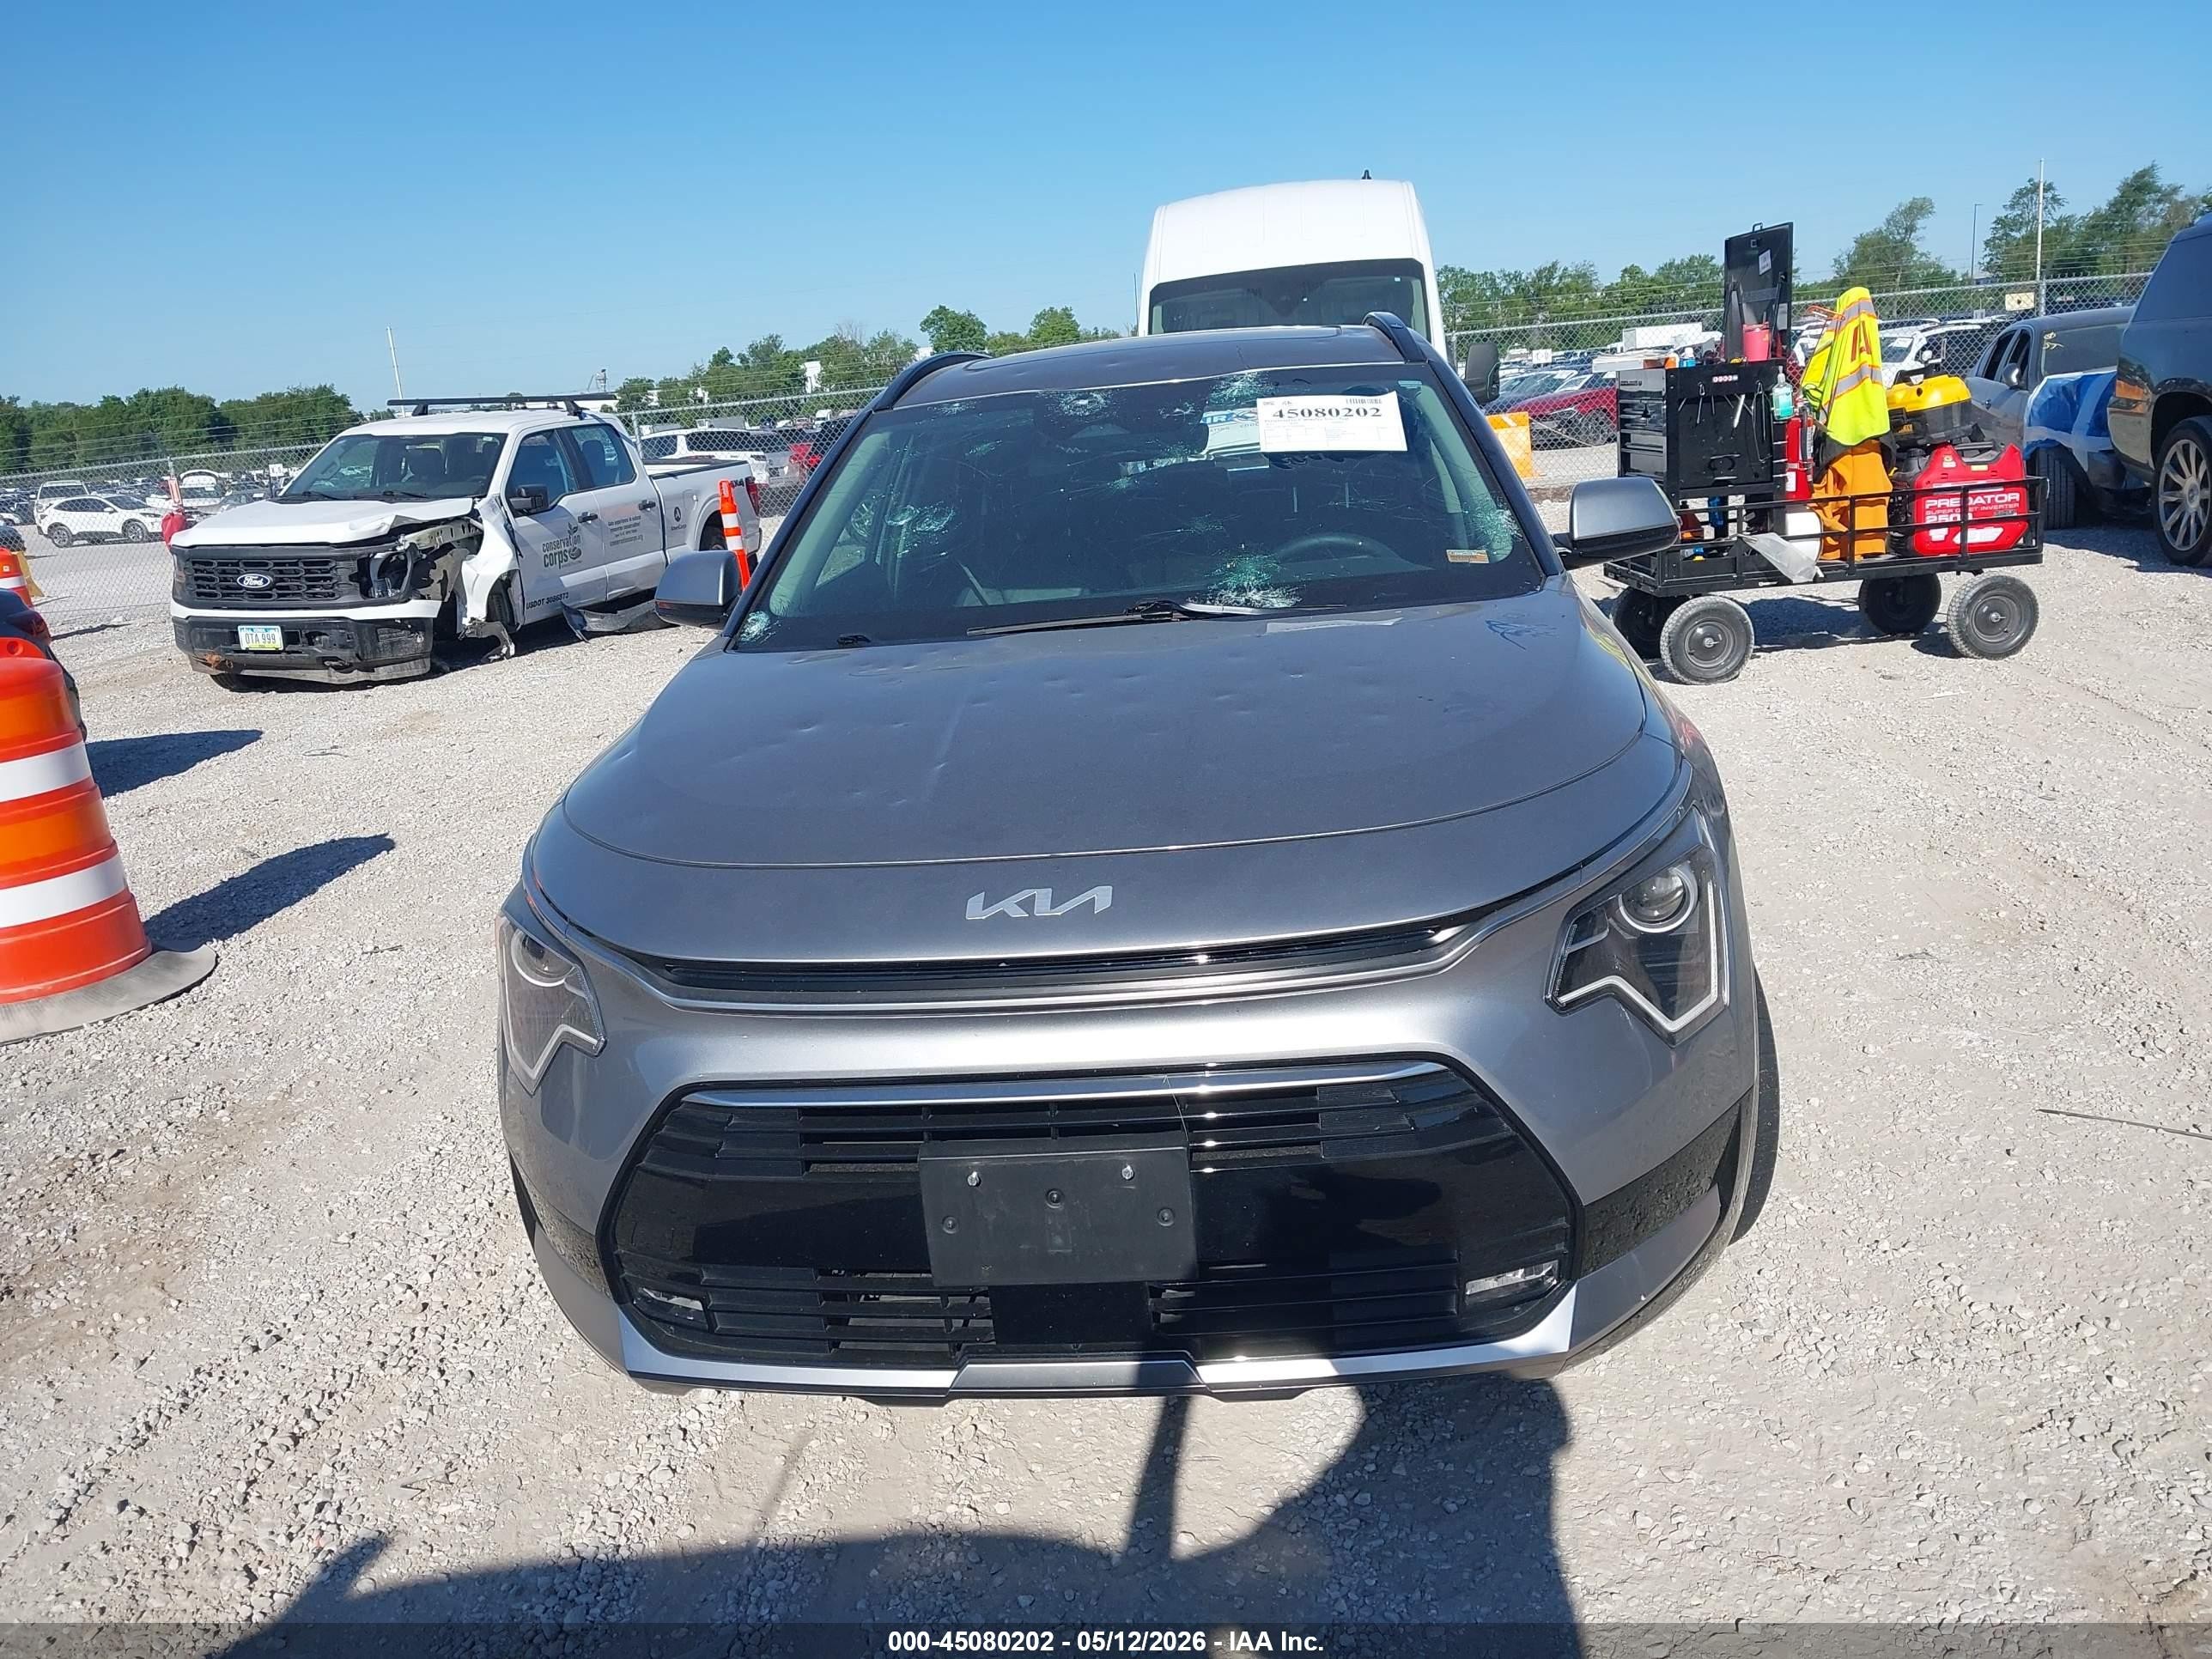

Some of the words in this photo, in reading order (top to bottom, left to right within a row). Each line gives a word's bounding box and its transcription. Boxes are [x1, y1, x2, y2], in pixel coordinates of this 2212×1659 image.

[1273, 406, 1382, 418] 45080202
[1980, 502, 2020, 511] INVERTER
[542, 534, 581, 553] conservation
[544, 549, 568, 569] corps
[243, 575, 264, 586] Ford
[526, 598, 545, 610] USDOT
[261, 633, 276, 644] 999
